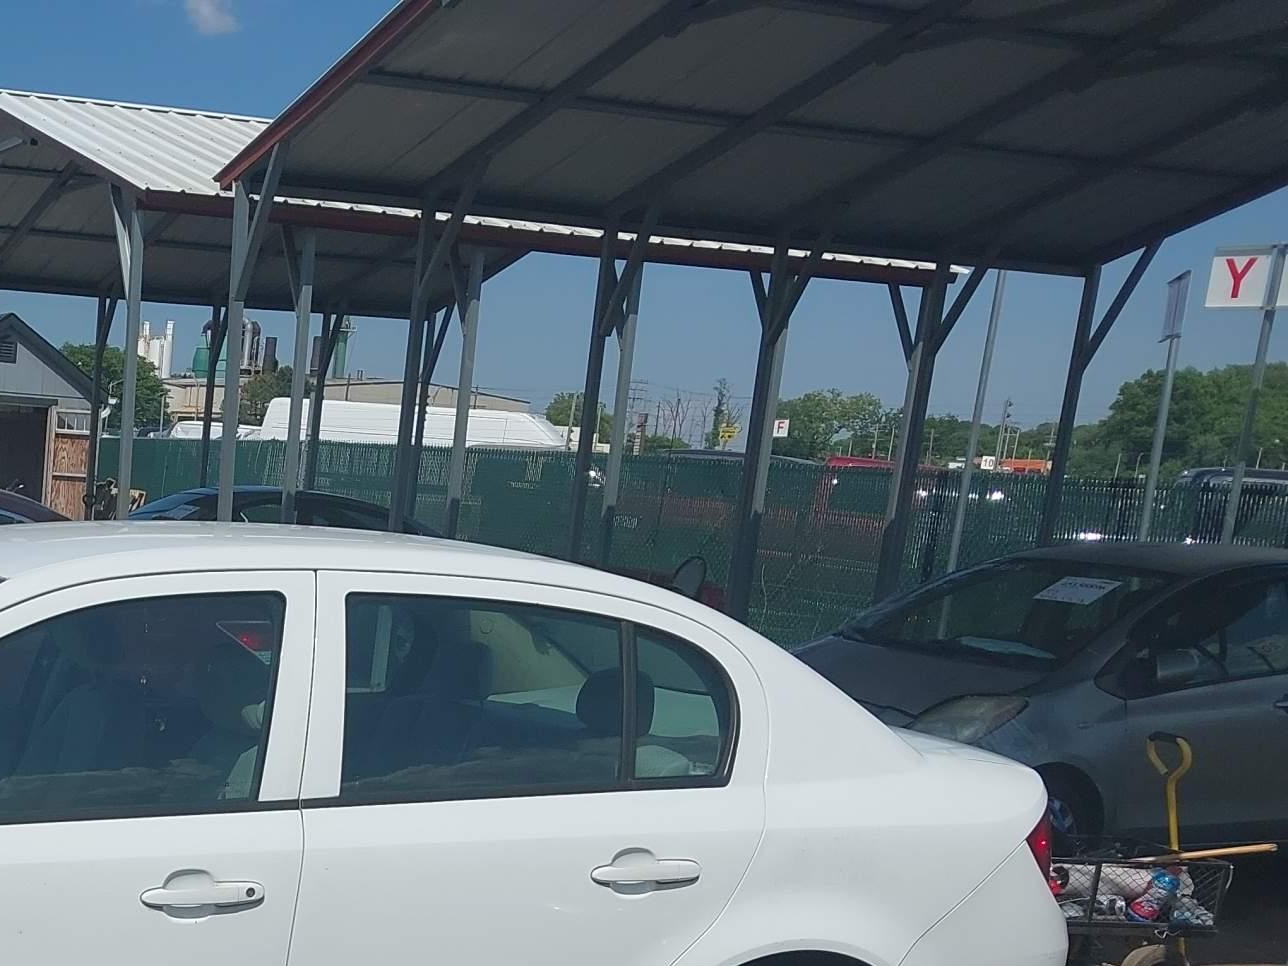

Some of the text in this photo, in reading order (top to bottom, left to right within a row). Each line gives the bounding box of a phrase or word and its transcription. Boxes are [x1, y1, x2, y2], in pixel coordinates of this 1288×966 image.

[1225, 257, 1258, 299] Y
[776, 421, 786, 435] F
[983, 458, 995, 468] 10
